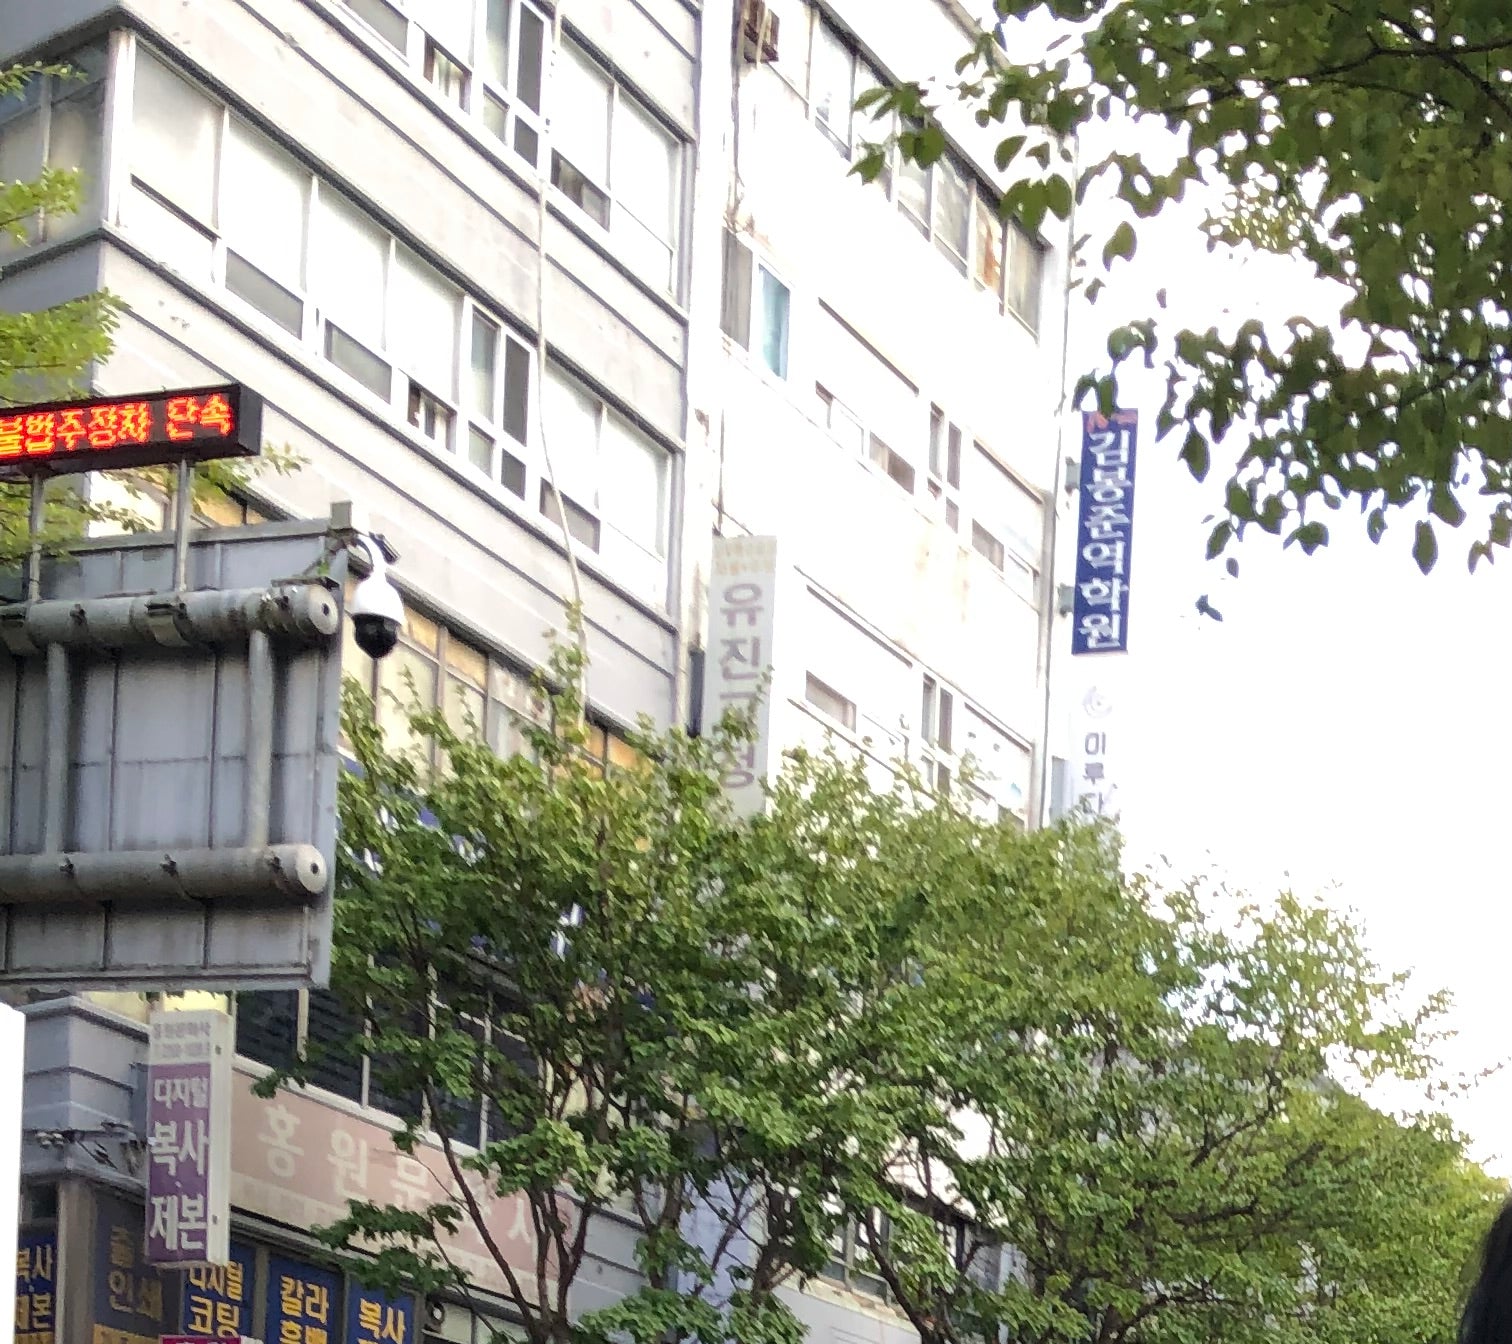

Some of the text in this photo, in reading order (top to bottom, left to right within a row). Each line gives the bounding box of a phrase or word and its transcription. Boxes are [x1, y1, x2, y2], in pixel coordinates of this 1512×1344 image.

[166, 394, 234, 440] 단속
[150, 1119, 209, 1176] 복사
[150, 1193, 208, 1250] 제본
[280, 1275, 330, 1324] 칼라
